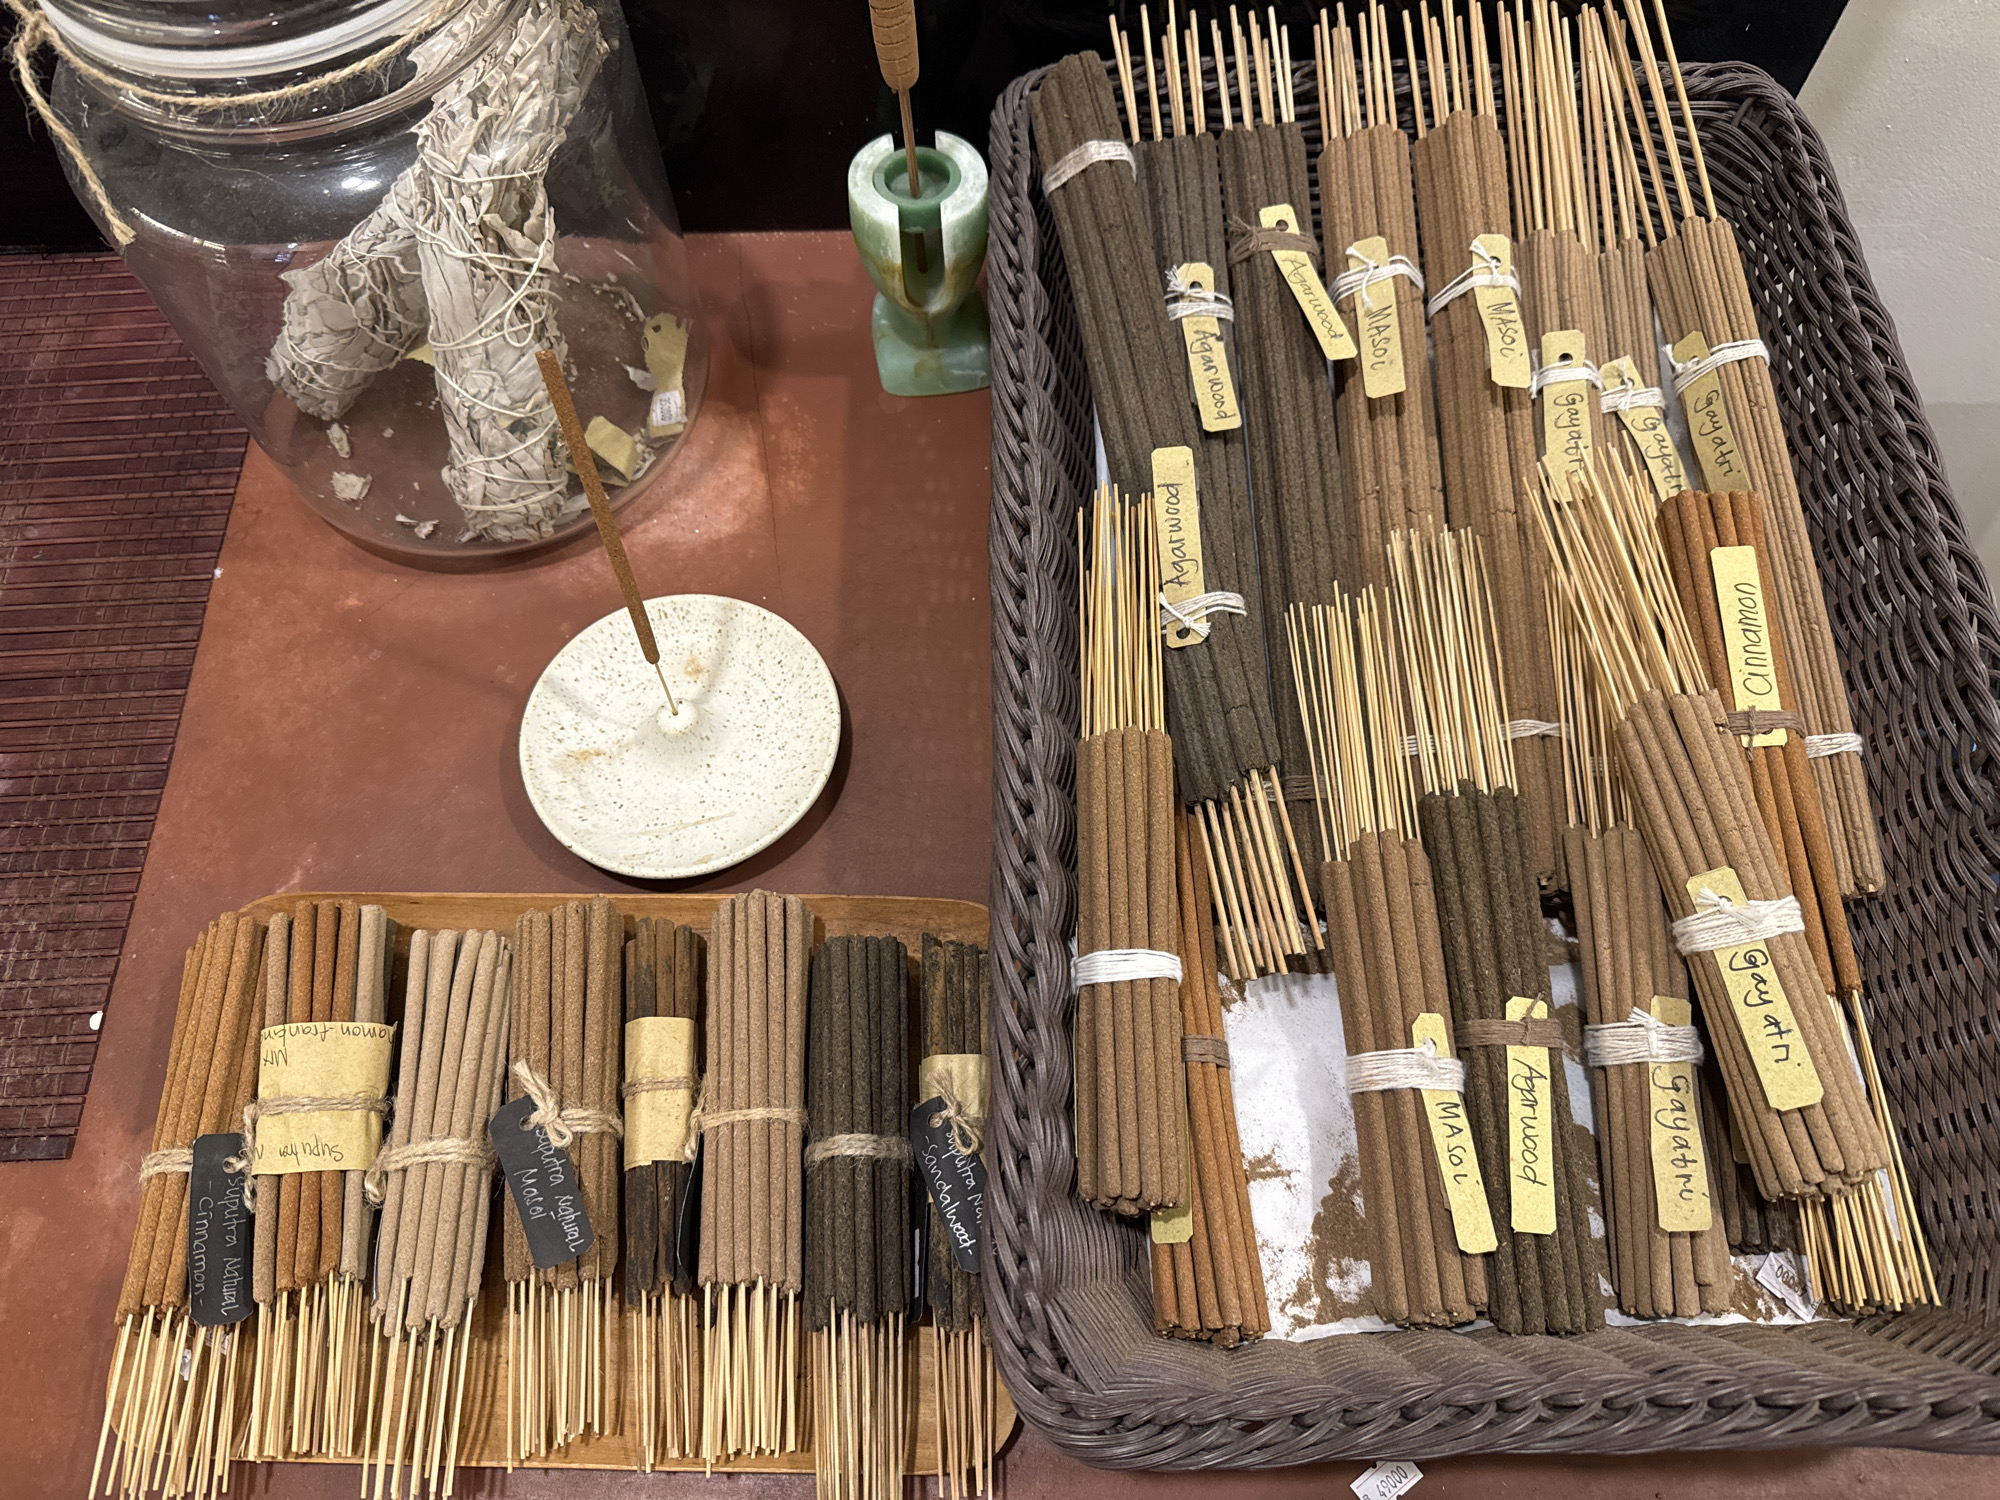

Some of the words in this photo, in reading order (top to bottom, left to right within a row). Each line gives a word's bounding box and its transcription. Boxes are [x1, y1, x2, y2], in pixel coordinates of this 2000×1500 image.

[1281, 258, 1343, 341] Agarwood
[1189, 329, 1236, 421] Agarwood
[1694, 389, 1732, 477] Gayatri
[1158, 482, 1199, 587] Agarwood
[1734, 582, 1773, 695] Cinnamon
[1729, 947, 1802, 1066] Gayatri
[1512, 1059, 1549, 1187] Agarwood
[1652, 1065, 1710, 1201] Gayatri
[1376, 1465, 1408, 1497] 49000
